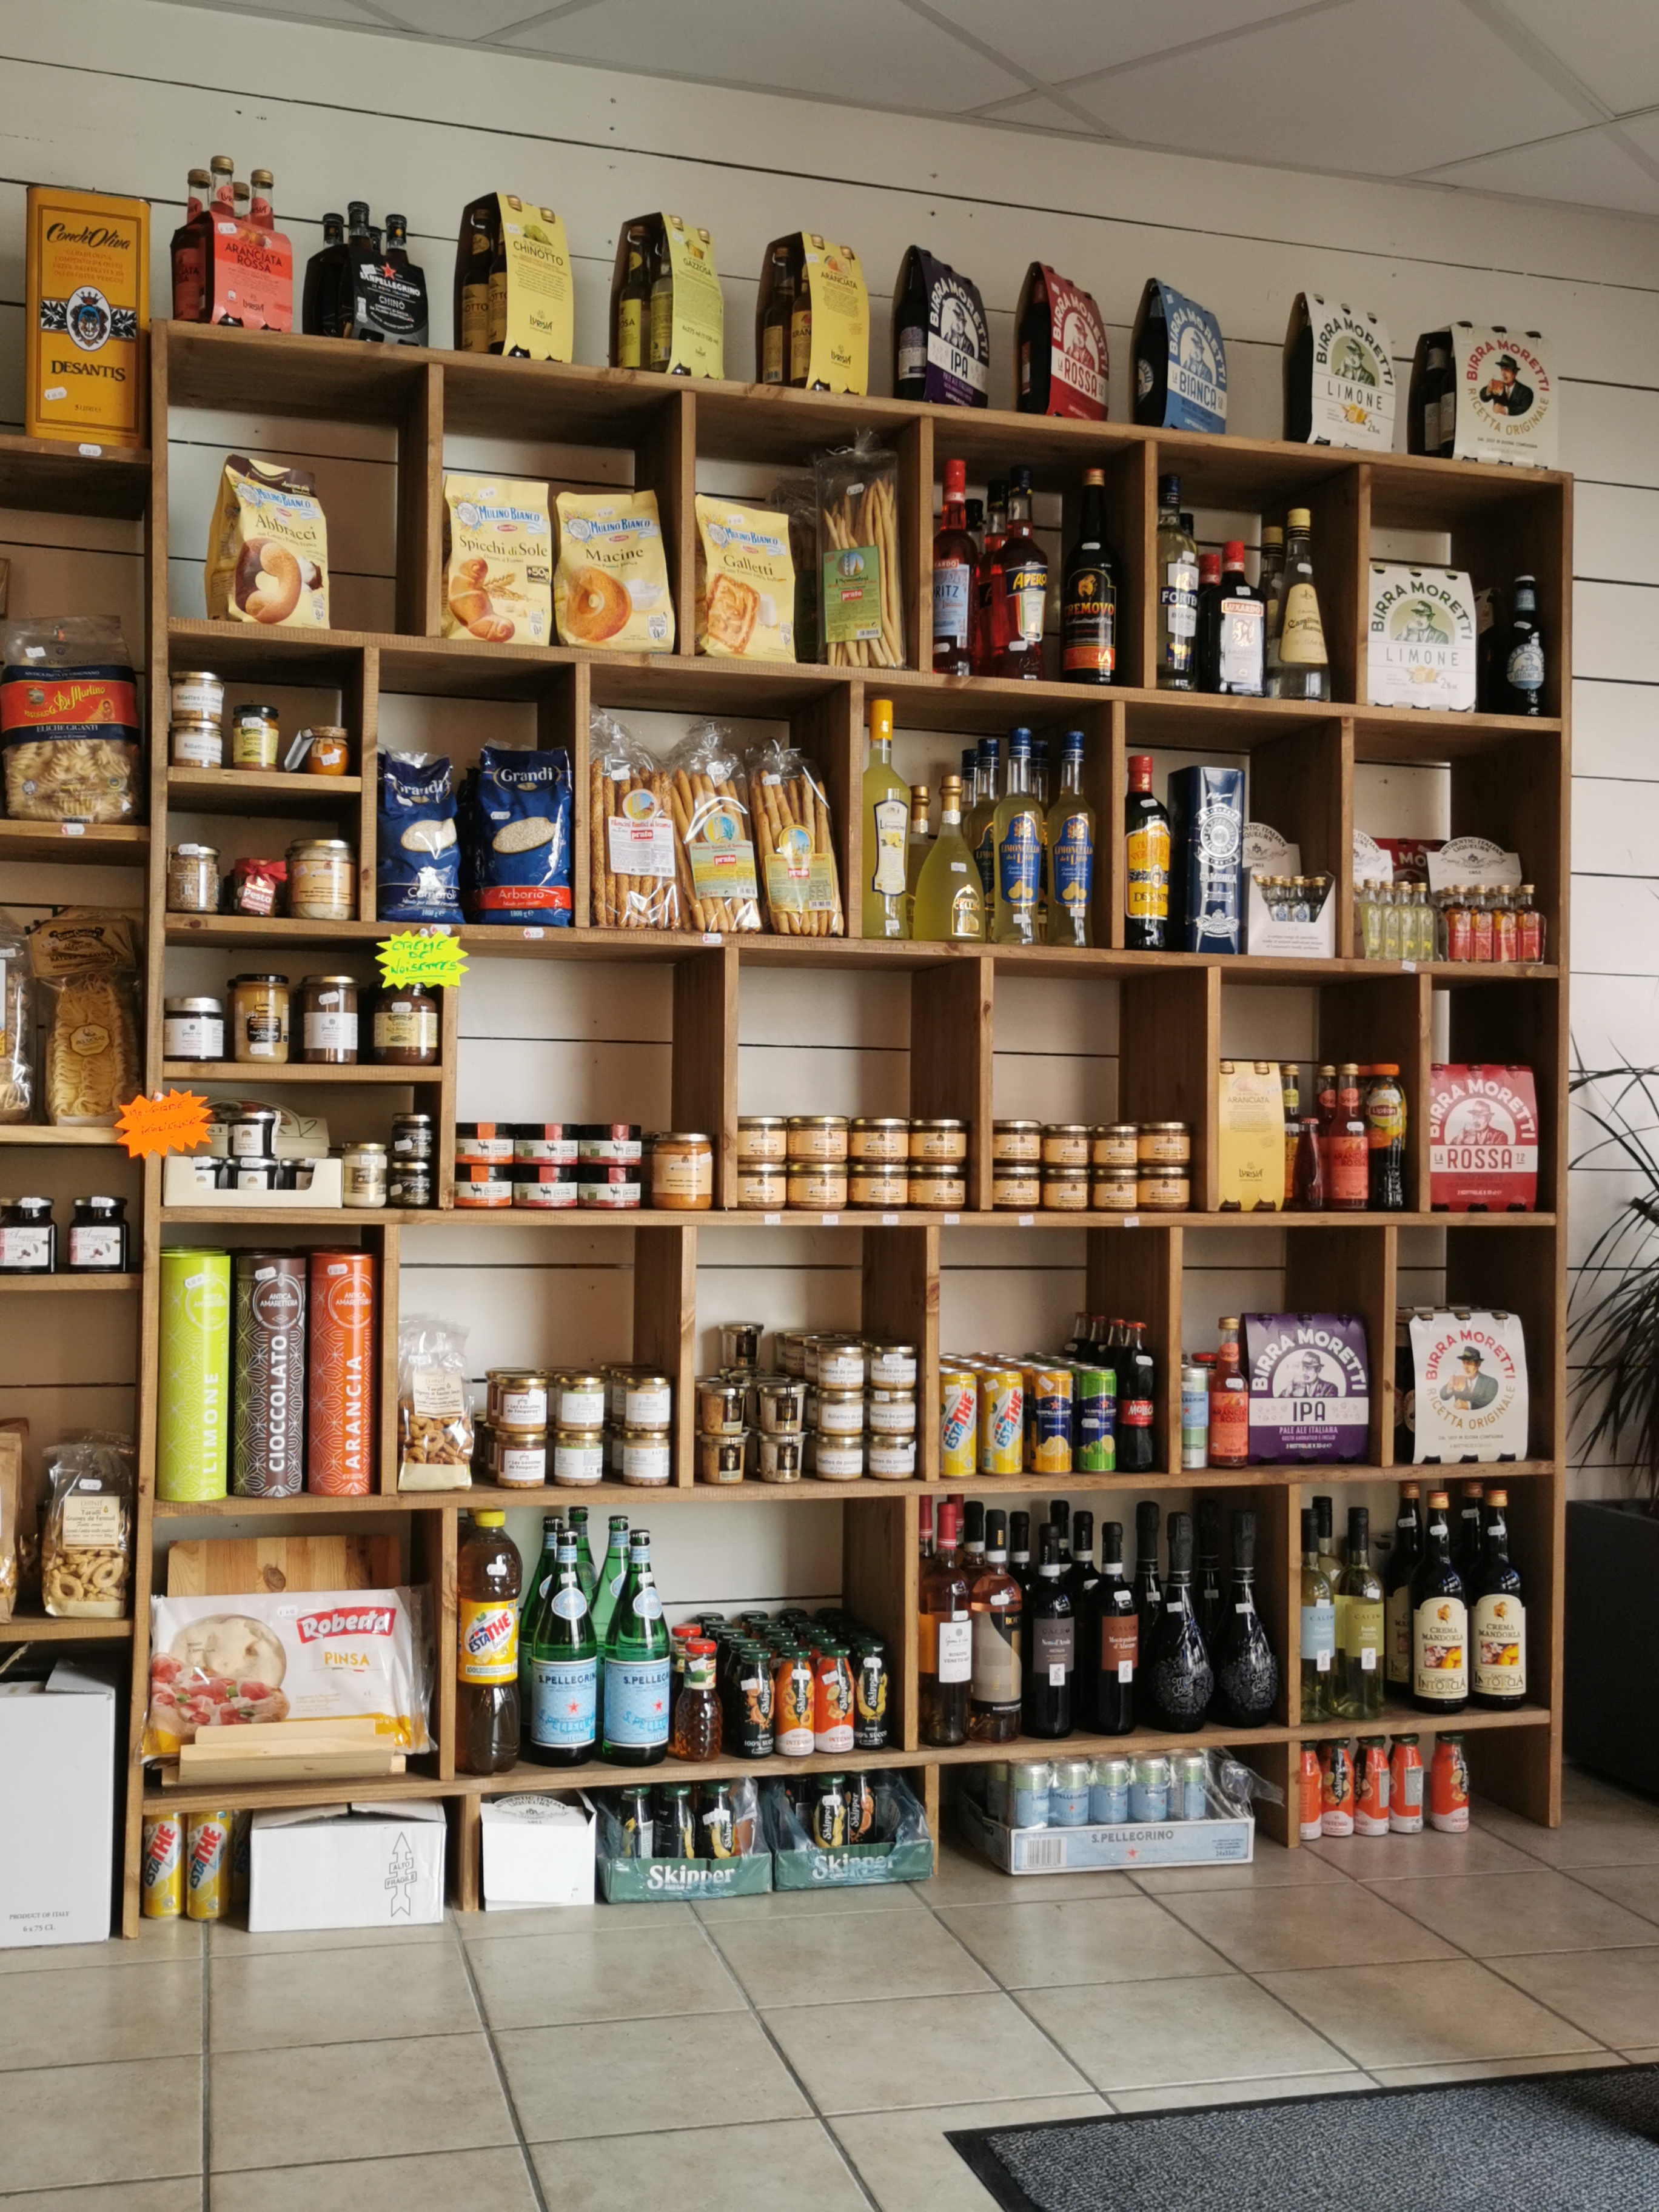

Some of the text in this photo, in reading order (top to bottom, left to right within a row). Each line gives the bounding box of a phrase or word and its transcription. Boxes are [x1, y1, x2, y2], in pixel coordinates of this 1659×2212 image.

[226, 243, 283, 267] ARANCIATA
[237, 254, 271, 273] ROSSA
[513, 241, 563, 267] CHINOTTO
[821, 271, 857, 290] ARANCIATA
[930, 278, 950, 328] BIRRA
[949, 278, 990, 359] MORETTI
[1052, 293, 1108, 373] BIRRA MORETTI
[1168, 308, 1227, 384] BIRRA MORETTI
[1315, 317, 1395, 386] BIRRA MORETTI
[51, 360, 126, 382] DESANTIS
[950, 349, 969, 380] IPA
[1466, 339, 1550, 392] BIRRA MORETTI
[1064, 357, 1098, 398] ROSSA
[1179, 370, 1218, 412] BIANCA
[1327, 380, 1384, 411] LIMONE
[1467, 387, 1549, 436] RICETTA ORIGINALE
[256, 488, 311, 510] MULINO BIANCO
[480, 505, 540, 522] MULINO BIANCO
[591, 517, 651, 534] MULINO BIANCO
[255, 514, 318, 540] Abbracci
[726, 527, 779, 546] MULINO BIANCO
[460, 534, 548, 557] Spicchi di Sole
[586, 548, 645, 563] Macine
[724, 554, 774, 576] Galletti
[842, 592, 862, 601] prato
[1371, 581, 1473, 640] BIRRA MORETTI
[1386, 646, 1460, 667] LIMONE
[501, 767, 554, 782] Grandi
[631, 831, 653, 840] prato
[1441, 838, 1504, 856] AUTHENTIC ITALIAN
[714, 856, 736, 866] prato
[788, 868, 809, 877] prato
[243, 888, 272, 903] Pesto
[498, 888, 545, 900] Arborio
[1467, 1079, 1536, 1139] MORETTI
[1434, 1148, 1512, 1169] LA ROSSA
[1251, 1329, 1367, 1391] BIRRA MORETTI
[1426, 1329, 1516, 1381] BIRRA MORETTI
[268, 1334, 288, 1472] CIOCCOLATO
[345, 1355, 364, 1470] ARANCIA
[1293, 1401, 1326, 1423] IPA
[1427, 1385, 1515, 1430] RICETTA ORIGINALE
[202, 1371, 220, 1475] LIMONE
[944, 1389, 976, 1450] ESTATHE
[995, 1389, 1022, 1449] ESTATHE
[1279, 1426, 1294, 1435] PALE
[469, 1611, 511, 1654] ESTATHE
[1421, 1633, 1463, 1641] MANDORLA
[1478, 1629, 1521, 1638] MANDORLA
[324, 1651, 369, 1666] PINSA
[538, 1673, 597, 1684] S.PELLEGRIN
[868, 1674, 879, 1707] Skipper
[1417, 1673, 1466, 1691] INTORCIA
[796, 1678, 806, 1714] Skipper
[839, 1676, 849, 1711] Skipper
[850, 1792, 859, 1828] Skipper
[822, 1806, 832, 1840] Skipper
[1091, 1829, 1174, 1843] S.PELLEGRINO
[145, 1823, 176, 1888] ESTATHE
[189, 1825, 222, 1891] ESTATHE
[392, 1860, 411, 1871] ALTO
[812, 1851, 894, 1881] Skipper
[386, 1873, 416, 1887] FRAGILE
[646, 1864, 736, 1891] Skipper
[9, 1912, 41, 1920] PRODUCT
[34, 1924, 44, 1932] 75
